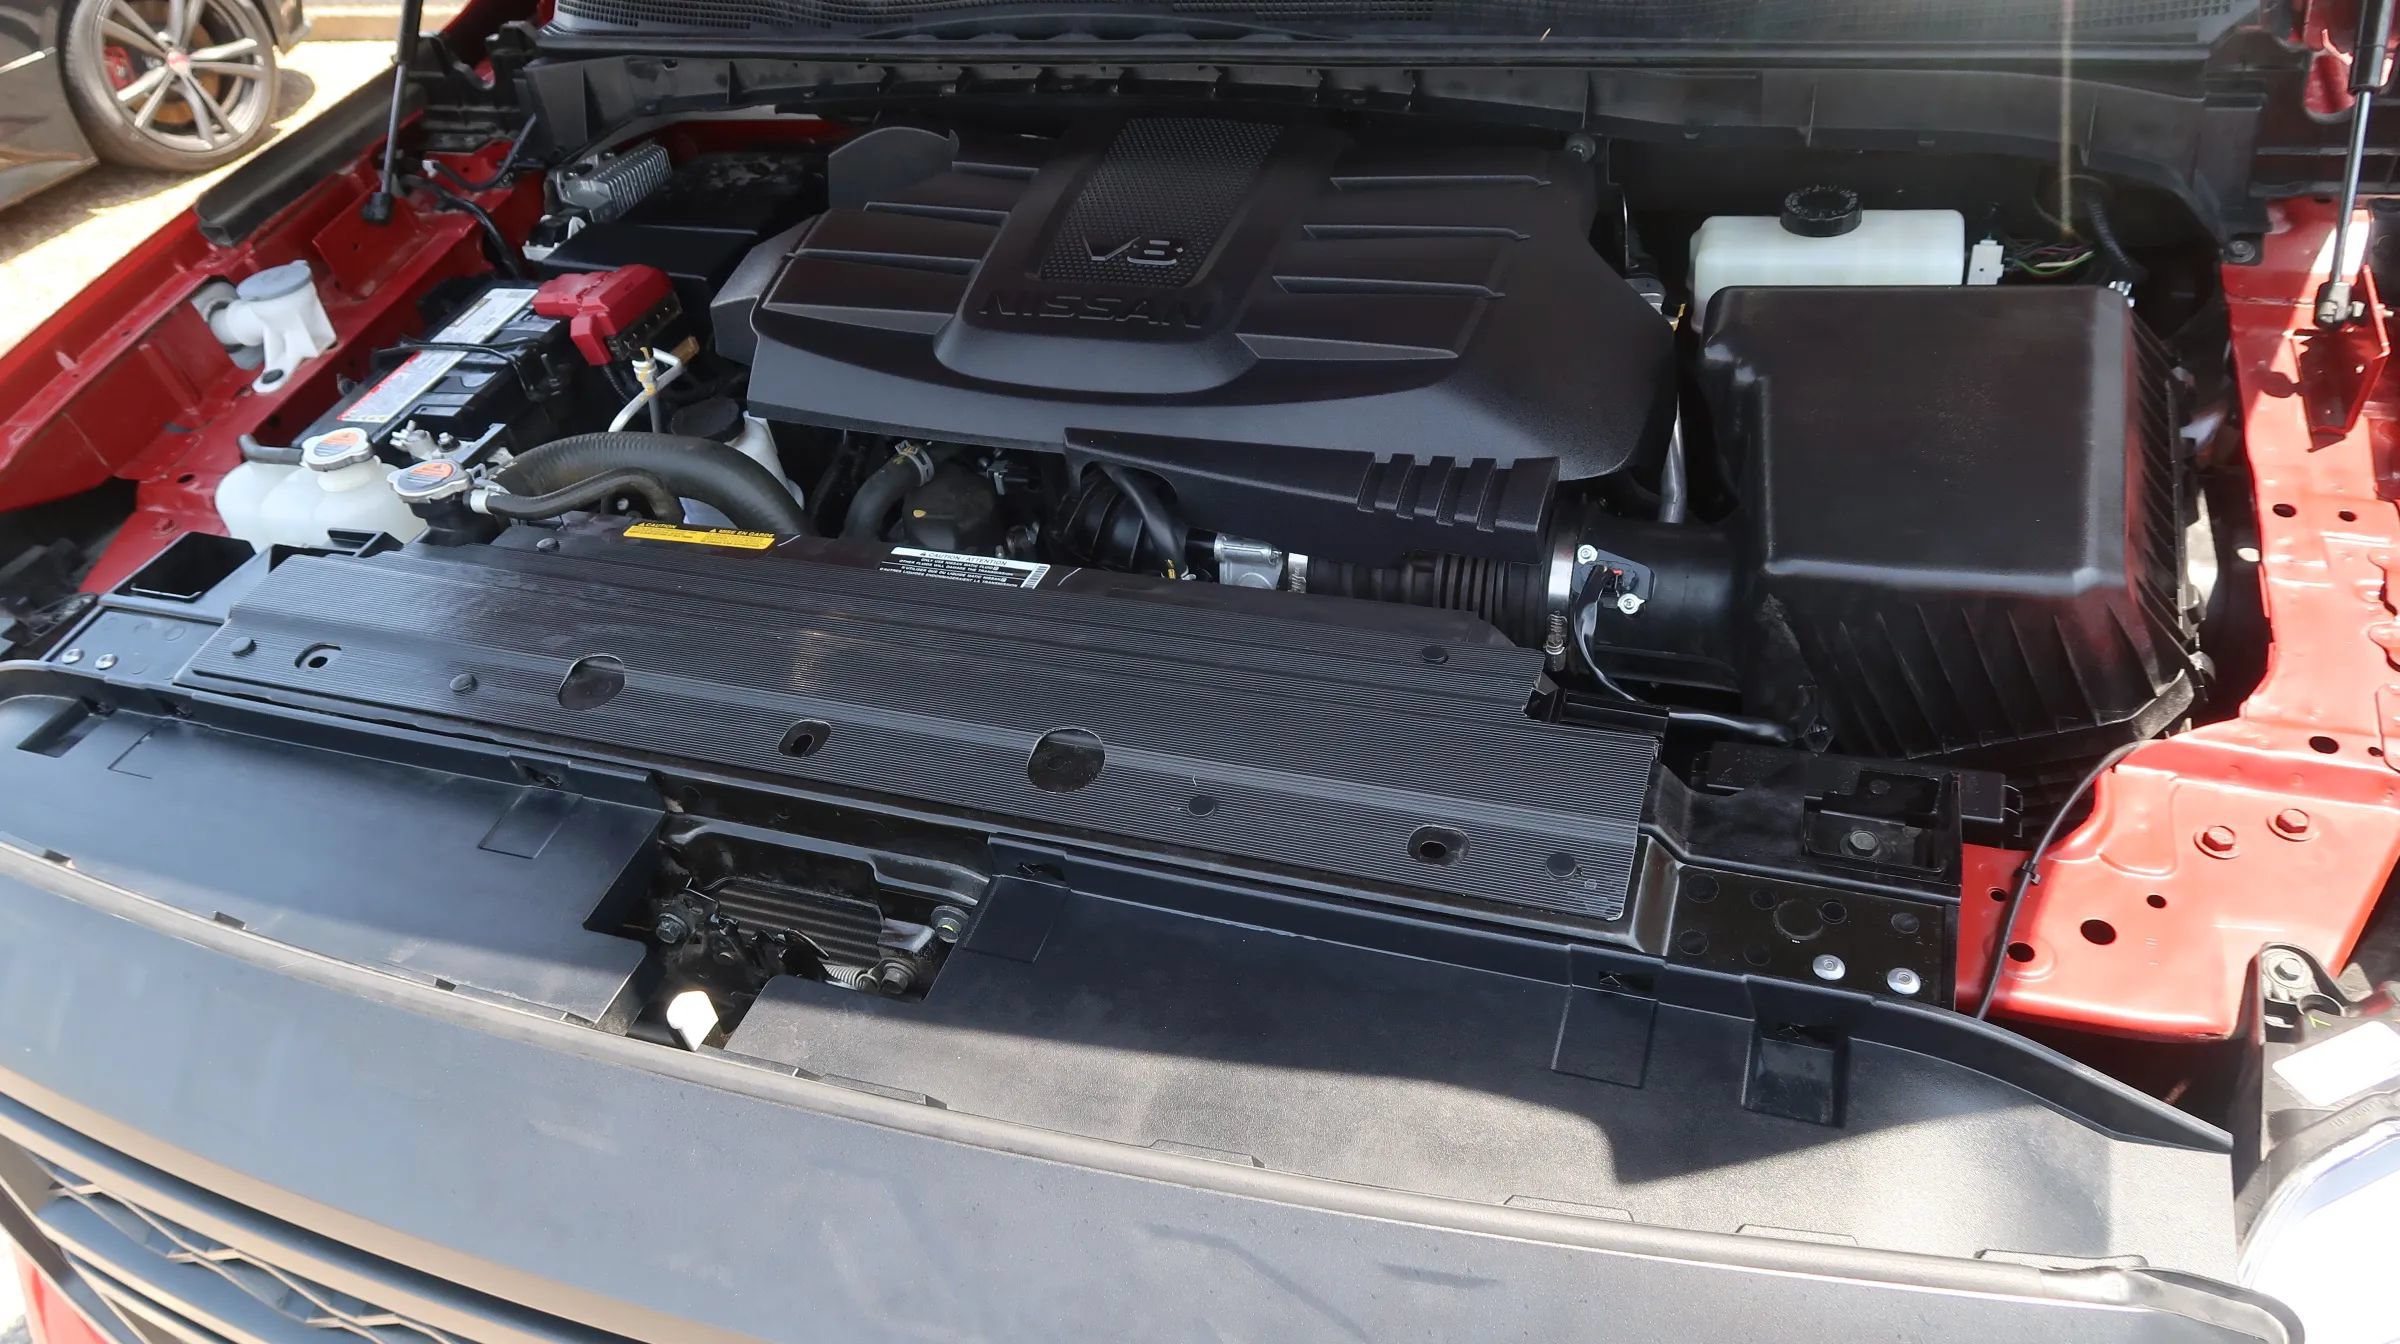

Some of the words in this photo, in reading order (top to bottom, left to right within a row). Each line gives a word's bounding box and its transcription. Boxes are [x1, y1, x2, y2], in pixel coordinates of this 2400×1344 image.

[1081, 235, 1184, 265] V8
[977, 293, 1206, 328] NISSAN
[928, 552, 960, 560] CAUTION
[966, 557, 1007, 566] ATTENTION
